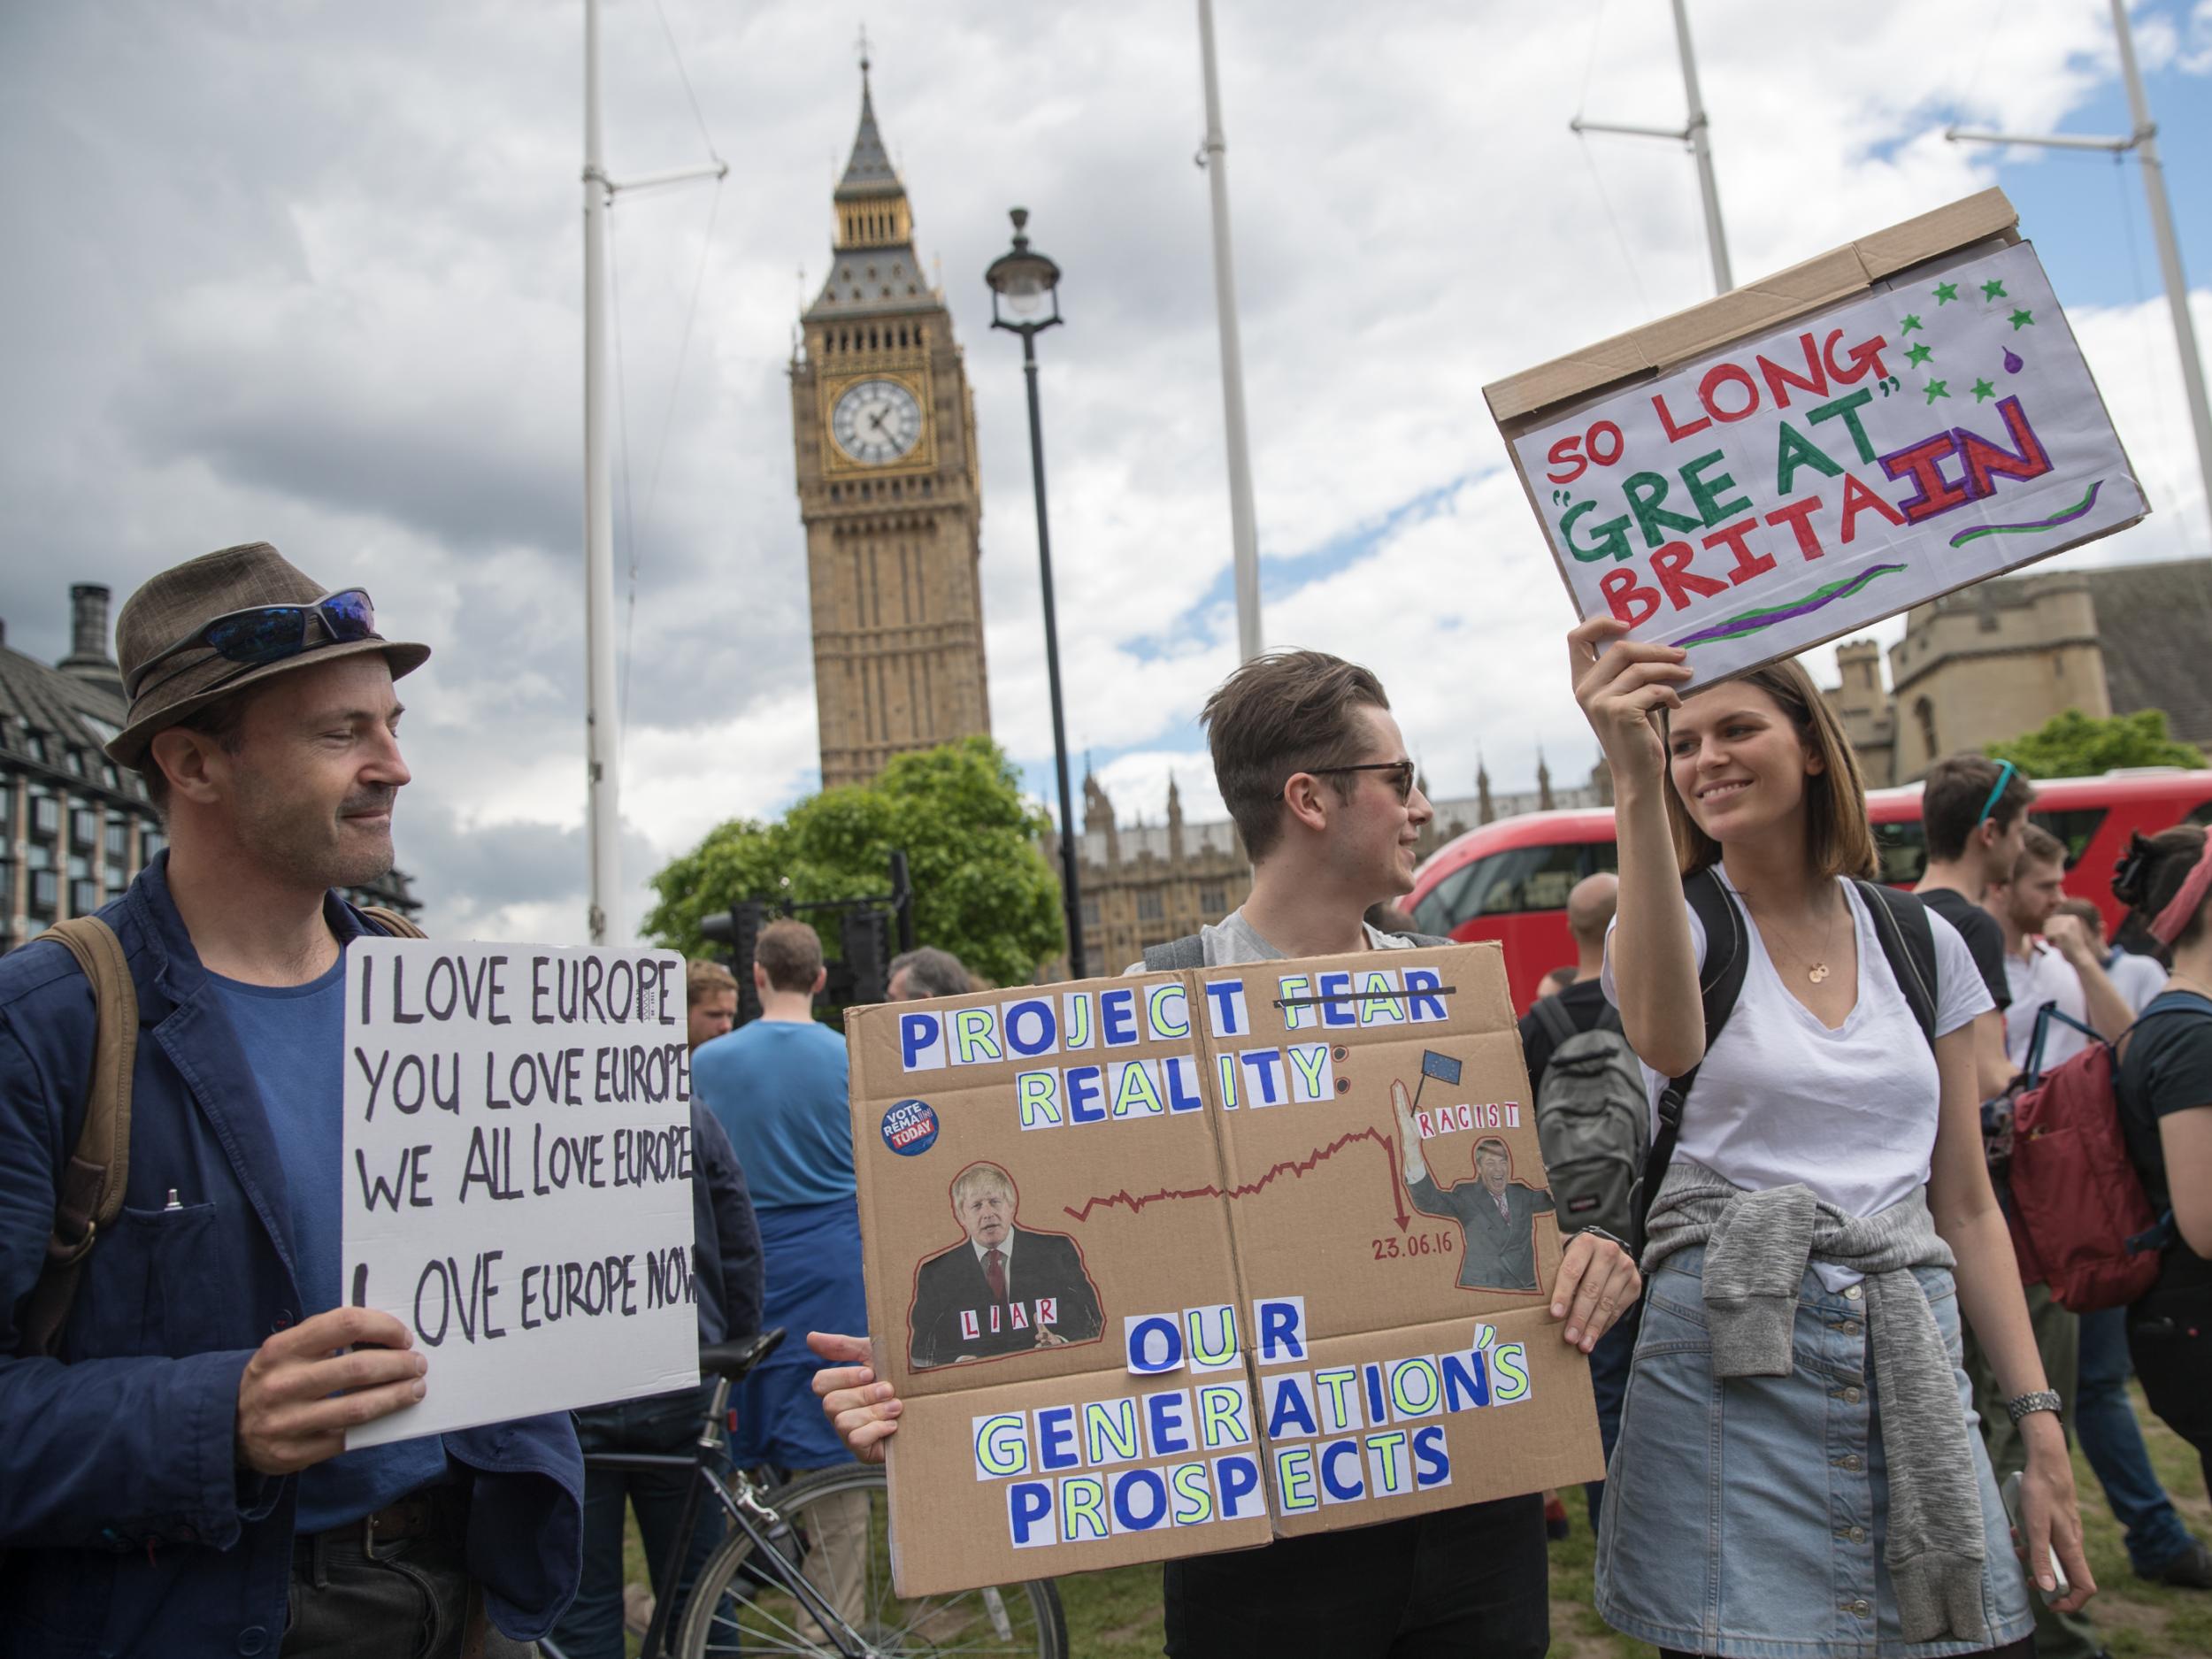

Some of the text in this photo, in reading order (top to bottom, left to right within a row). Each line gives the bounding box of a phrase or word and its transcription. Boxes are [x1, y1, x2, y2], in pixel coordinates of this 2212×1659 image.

[1547, 328, 1888, 484] SO LONG
[1600, 395, 2054, 631] BRITAIN
[361, 956, 373, 1025] I
[394, 956, 511, 1025] LOVE
[532, 956, 678, 1025] EUROPE
[902, 970, 1448, 1069] PROJECT FEAR
[354, 1043, 690, 1121] YOU LOVE EUROPE
[887, 1102, 921, 1123] VOTE
[1418, 1103, 1518, 1137] RACIST
[355, 1124, 693, 1212] WE ALL LOVE EUROPE
[892, 1119, 932, 1146] TODAY
[1372, 1231, 1453, 1260] 23.06.16
[520, 1255, 638, 1330] EUROPE
[647, 1244, 697, 1310] NOW
[964, 1299, 1055, 1336] LIAR
[1128, 1302, 1304, 1372] OUR
[976, 1325, 1529, 1477] GENERATION'S
[1011, 1425, 1449, 1545] PROSPECTS
